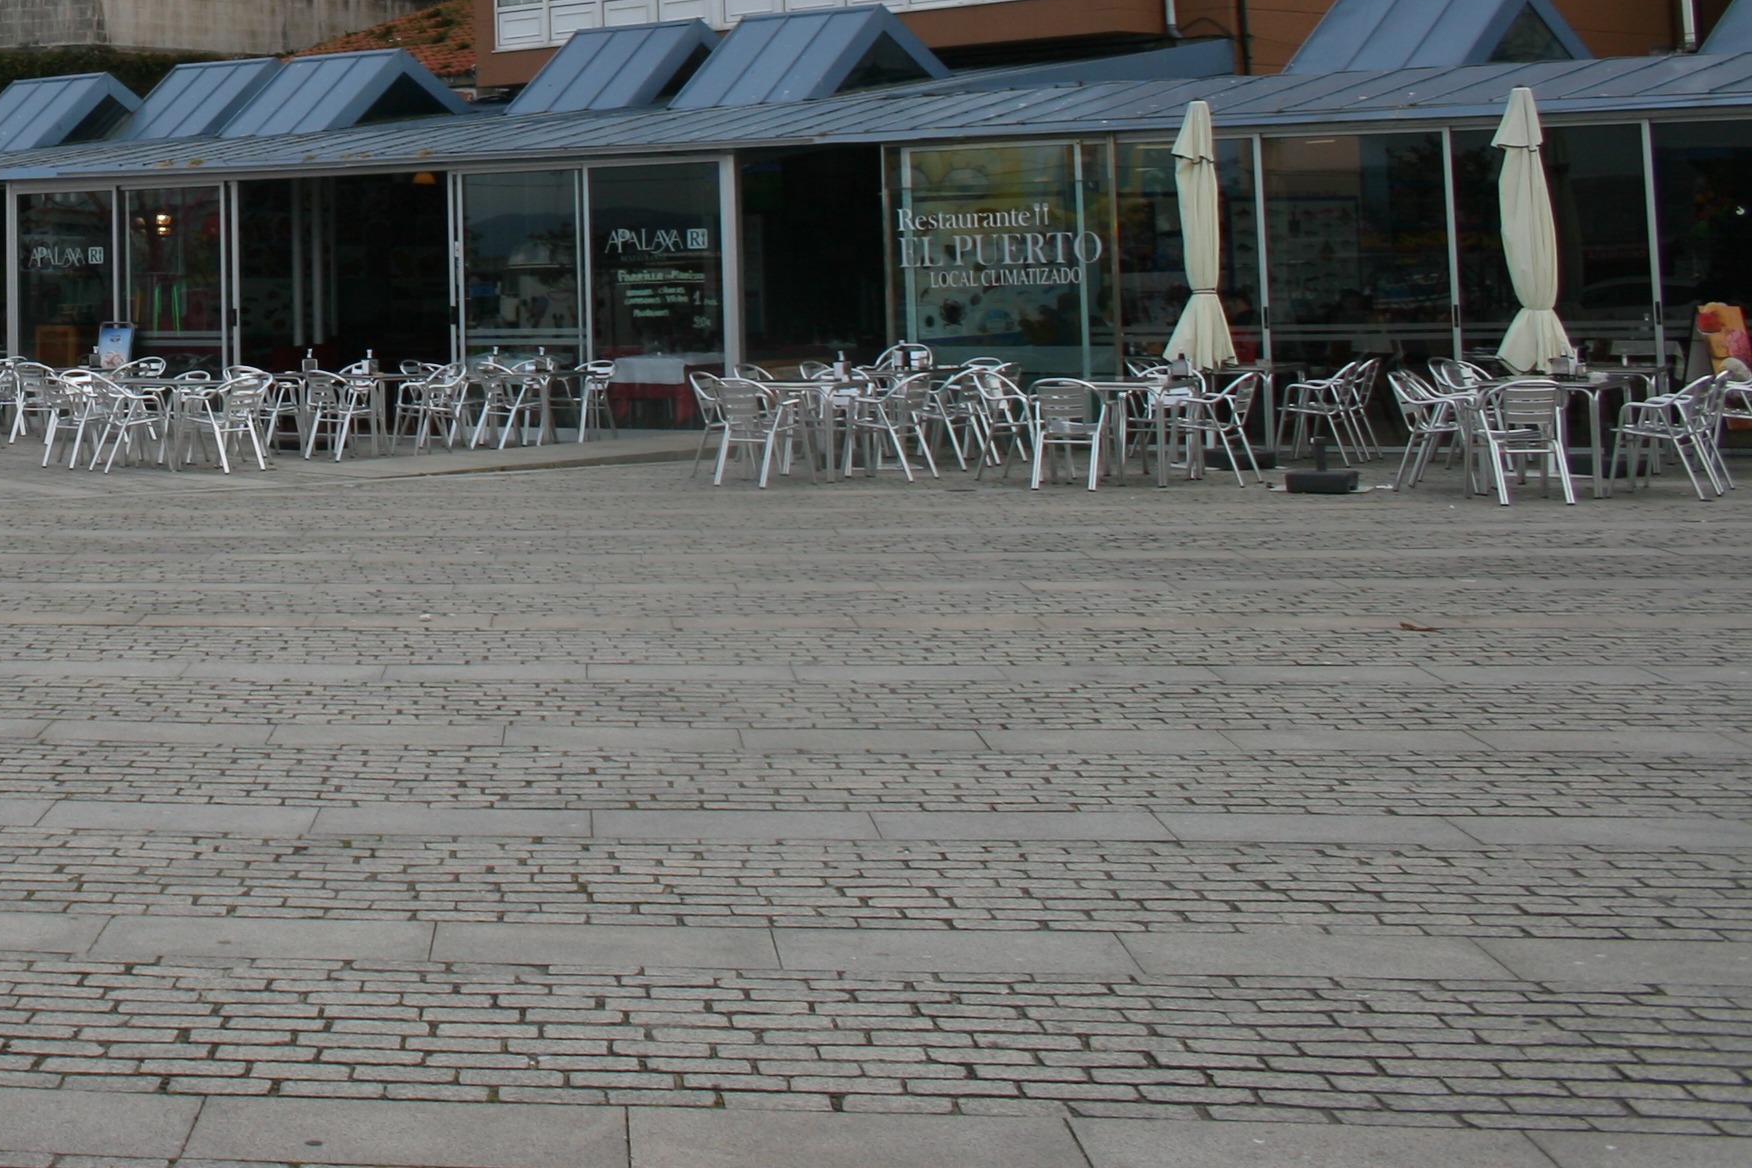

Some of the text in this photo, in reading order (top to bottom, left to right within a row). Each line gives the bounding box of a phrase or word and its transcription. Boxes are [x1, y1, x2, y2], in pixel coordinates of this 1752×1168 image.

[897, 207, 1031, 232] Restaurante
[900, 231, 1103, 268] EL PUERTO
[930, 267, 1082, 288] LOCAL CLIMATIZADO
